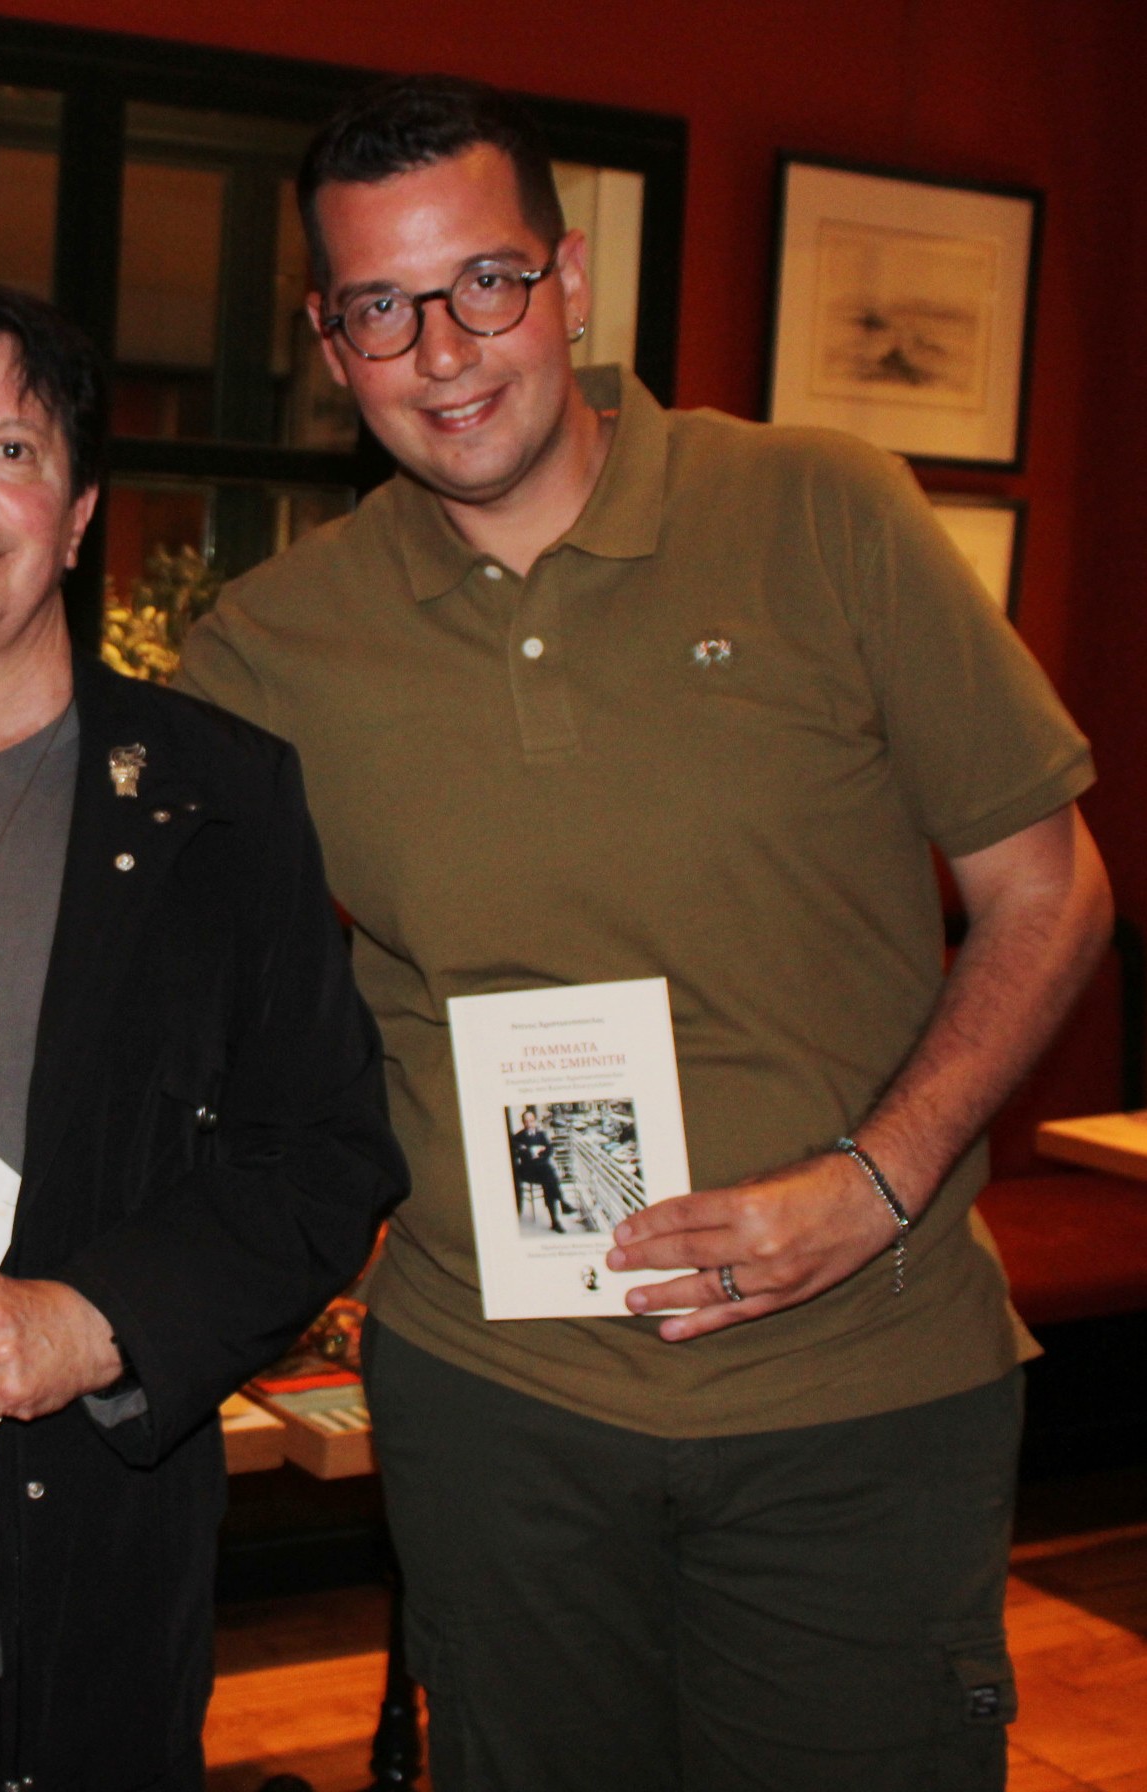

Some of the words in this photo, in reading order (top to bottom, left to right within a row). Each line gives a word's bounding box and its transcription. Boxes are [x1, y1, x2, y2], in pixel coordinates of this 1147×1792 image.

[523, 1042, 598, 1057] ΓΡΑΜΜΑΤΑ
[519, 1060, 556, 1072] ΕΝΑΝ
[560, 1054, 626, 1069] ΣΜΗΝΙΤΗ
